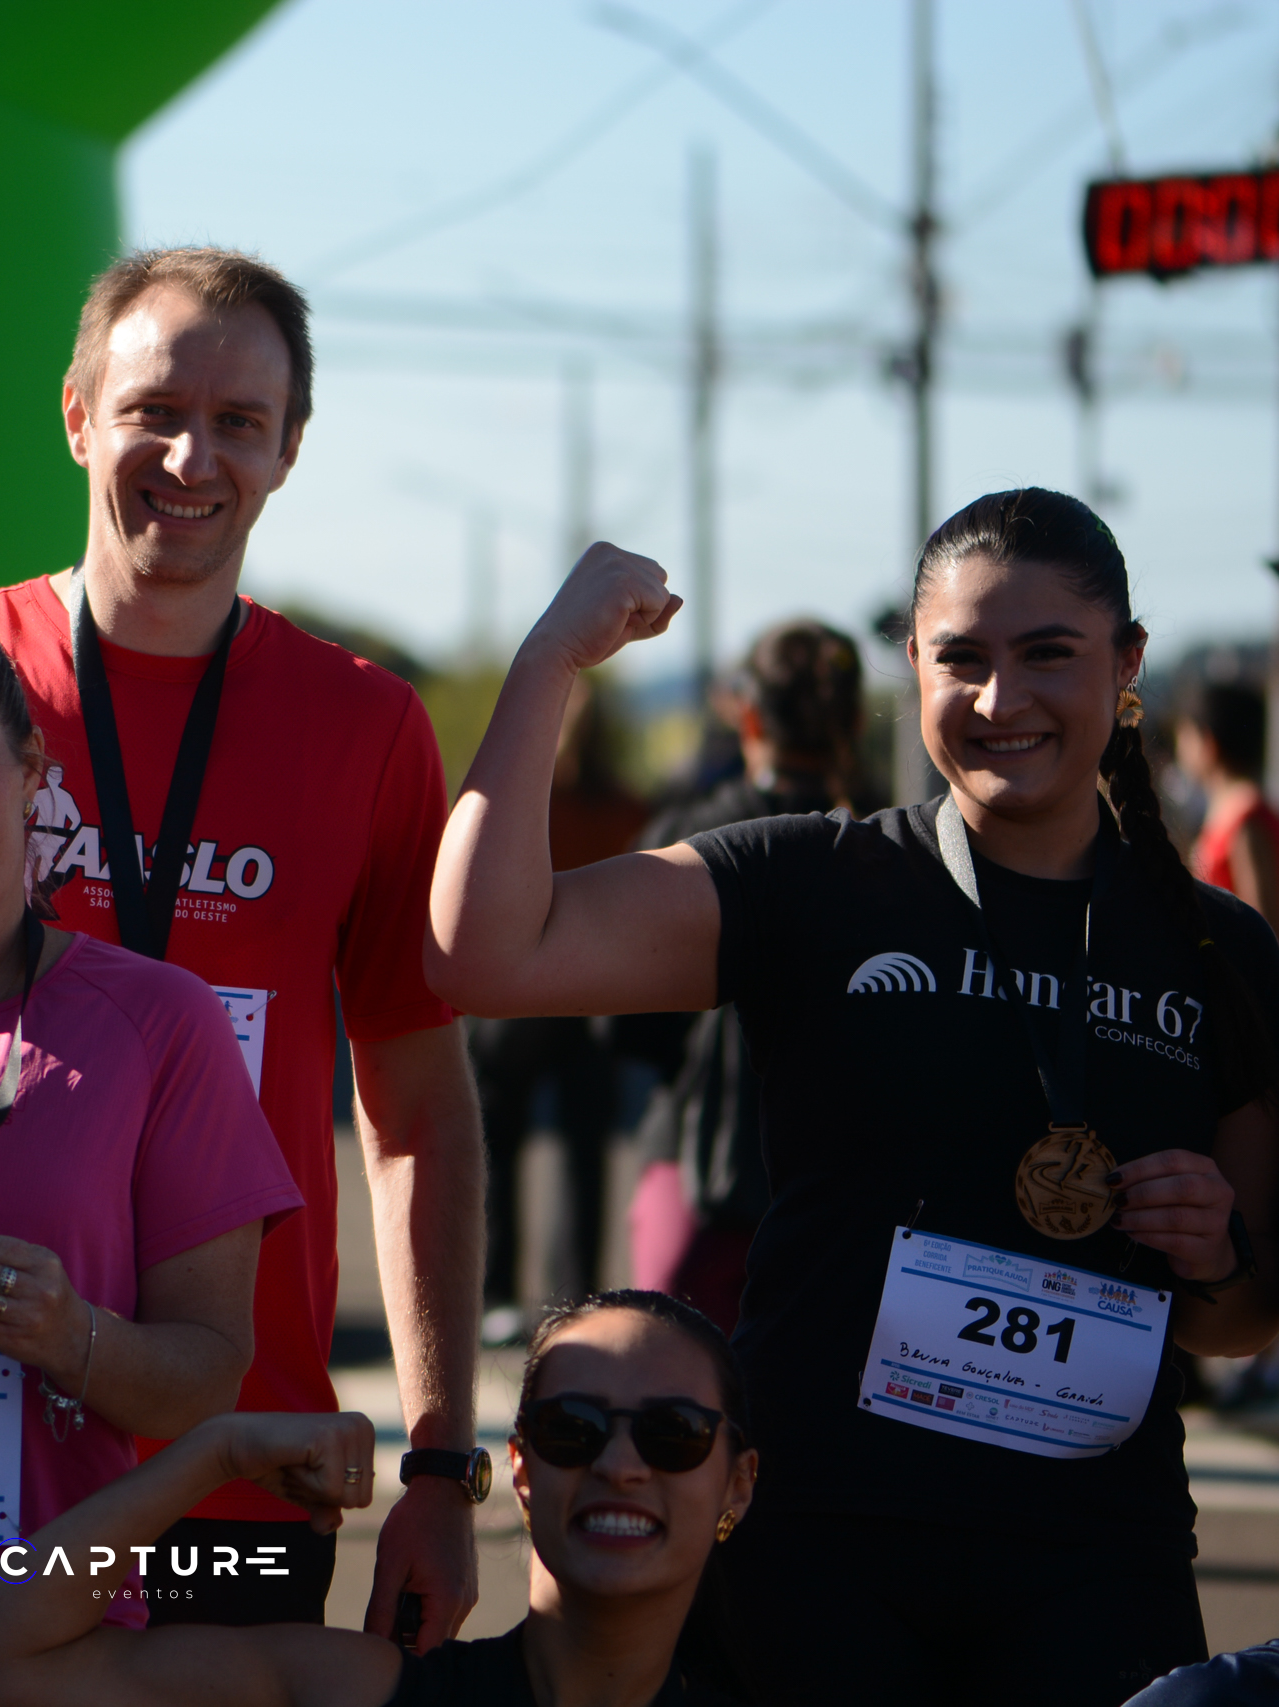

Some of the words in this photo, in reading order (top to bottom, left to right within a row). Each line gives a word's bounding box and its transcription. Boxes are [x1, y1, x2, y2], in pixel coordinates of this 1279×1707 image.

[89, 897, 110, 909] SÃO
[175, 898, 237, 913] ATLETISMO
[175, 909, 189, 919] DO
[193, 911, 228, 923] OESTE
[1156, 990, 1203, 1044] 67
[1094, 1025, 1201, 1071] CONFECÇÕES
[930, 1240, 952, 1252] EDIÇÃO
[922, 1250, 948, 1262] CORRIDA
[914, 1259, 952, 1274] BENEFICENTE
[967, 1264, 1004, 1276] PRATIQUE
[1004, 1270, 1029, 1284] AJUDA
[1041, 1279, 1061, 1292] ONG
[1097, 1300, 1134, 1318] CAUSA
[957, 1296, 1076, 1364] 281
[898, 1374, 932, 1390] Sicredi
[974, 1393, 1000, 1405] CRESOL
